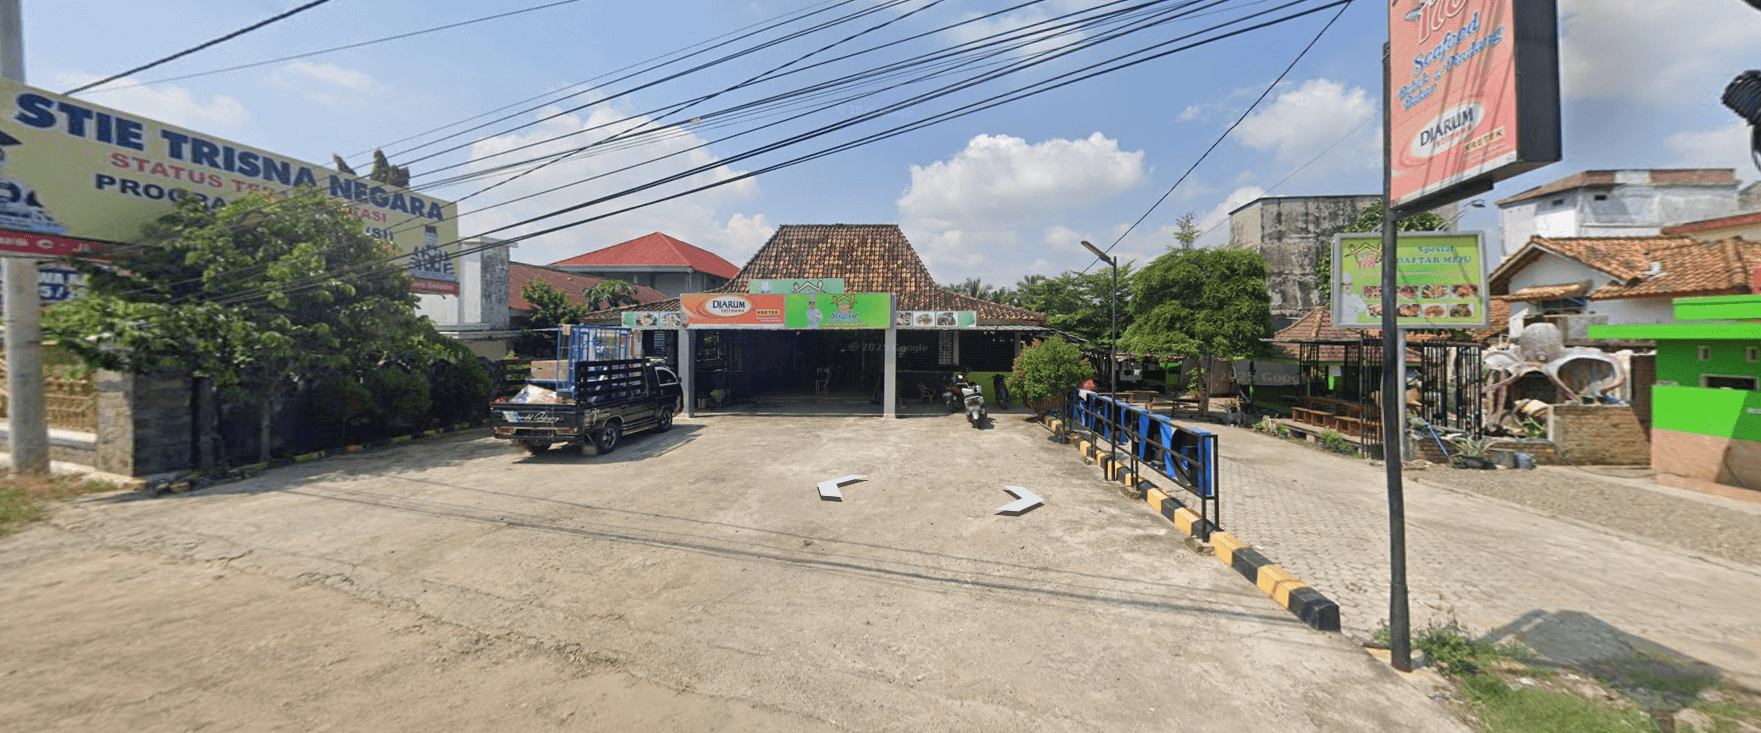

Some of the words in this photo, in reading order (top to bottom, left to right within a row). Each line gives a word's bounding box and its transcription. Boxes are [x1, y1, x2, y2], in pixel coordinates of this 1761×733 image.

[1412, 11, 1480, 77] Seafood
[1420, 107, 1474, 147] DJARUM
[1465, 130, 1503, 151] KRETEK
[15, 93, 145, 151] STIE
[161, 129, 317, 188] TRISNA
[328, 174, 445, 222] NEGARA
[111, 152, 224, 189] STATUS
[1397, 256, 1440, 265] DAFTAR
[712, 300, 745, 309] DJARUM
